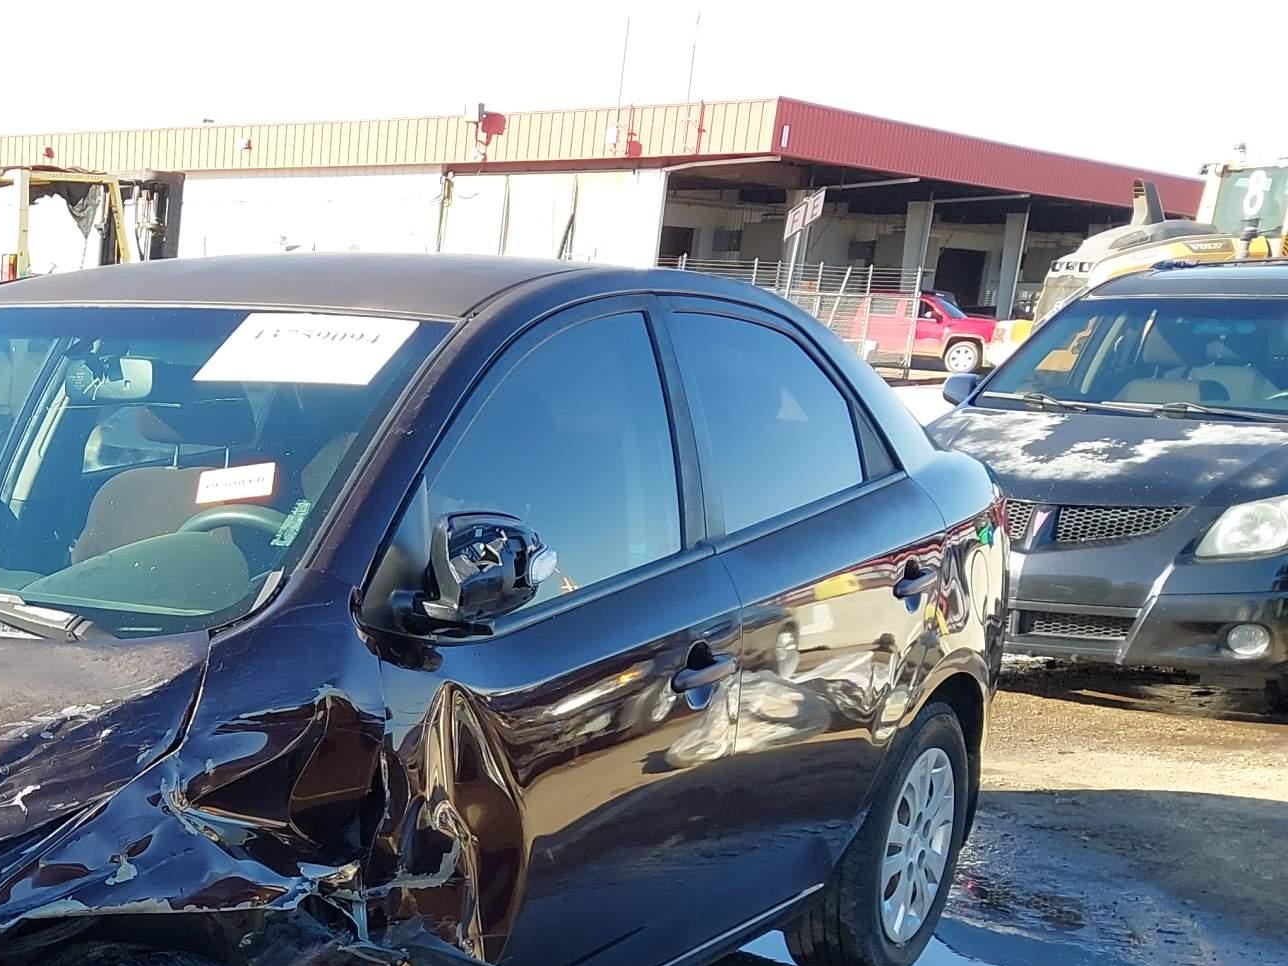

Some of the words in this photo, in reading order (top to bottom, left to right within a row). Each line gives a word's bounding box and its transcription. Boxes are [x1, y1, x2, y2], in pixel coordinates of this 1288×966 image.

[1243, 169, 1267, 216] 8
[810, 196, 821, 219] E
[791, 210, 801, 233] F
